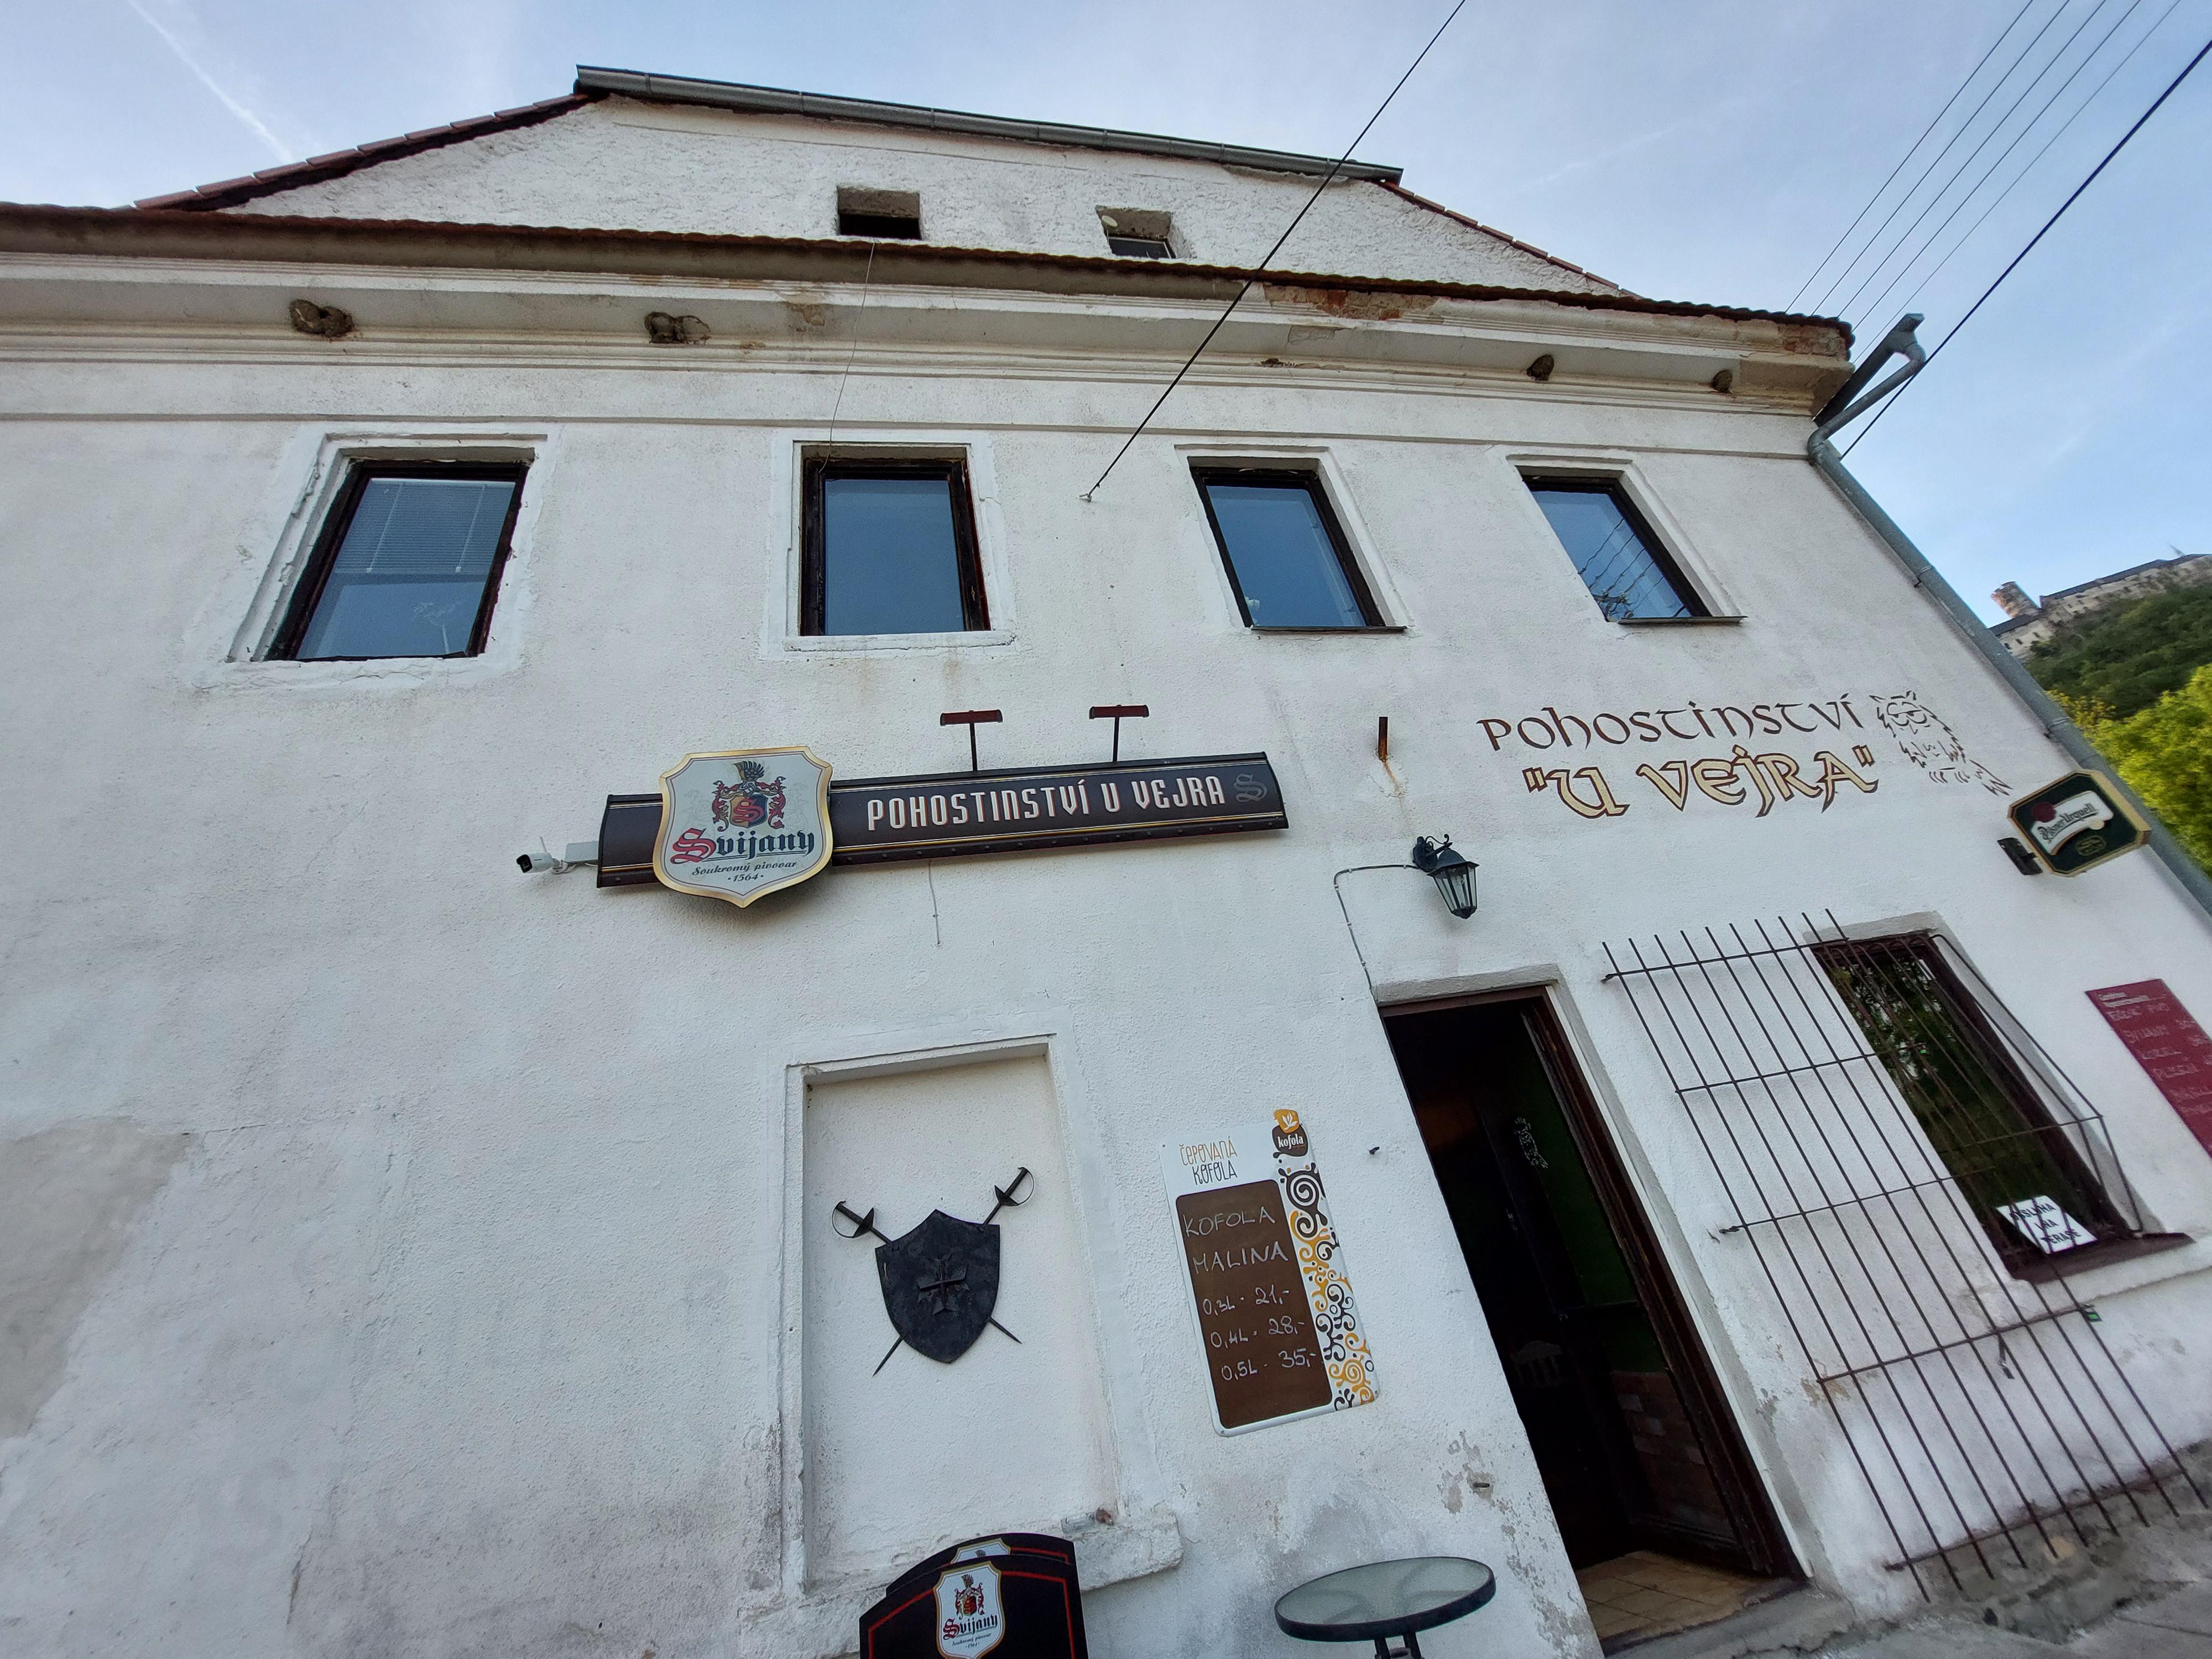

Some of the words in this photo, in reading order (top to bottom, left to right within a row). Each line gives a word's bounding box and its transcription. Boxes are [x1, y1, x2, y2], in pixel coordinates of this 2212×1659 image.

[867, 779, 1091, 831] POHOSTINSTVÍ
[1100, 783, 1121, 813] U
[1134, 776, 1226, 810] VEJRA
[670, 827, 815, 863] Svijany
[692, 863, 750, 875] Soukromý
[754, 862, 797, 872] pivovar
[1179, 1135, 1238, 1166] ČEPOVANÁ
[1277, 1134, 1303, 1149] kofola
[1192, 1160, 1238, 1185] KOFOLA
[1183, 1207, 1275, 1237] KOFOLA
[1193, 1241, 1289, 1274] MALINA
[1202, 1296, 1235, 1316] 0,3L
[1210, 1328, 1249, 1349] 0,4L
[1221, 1359, 1258, 1380] 0,5L
[943, 1614, 998, 1640] Svijany
